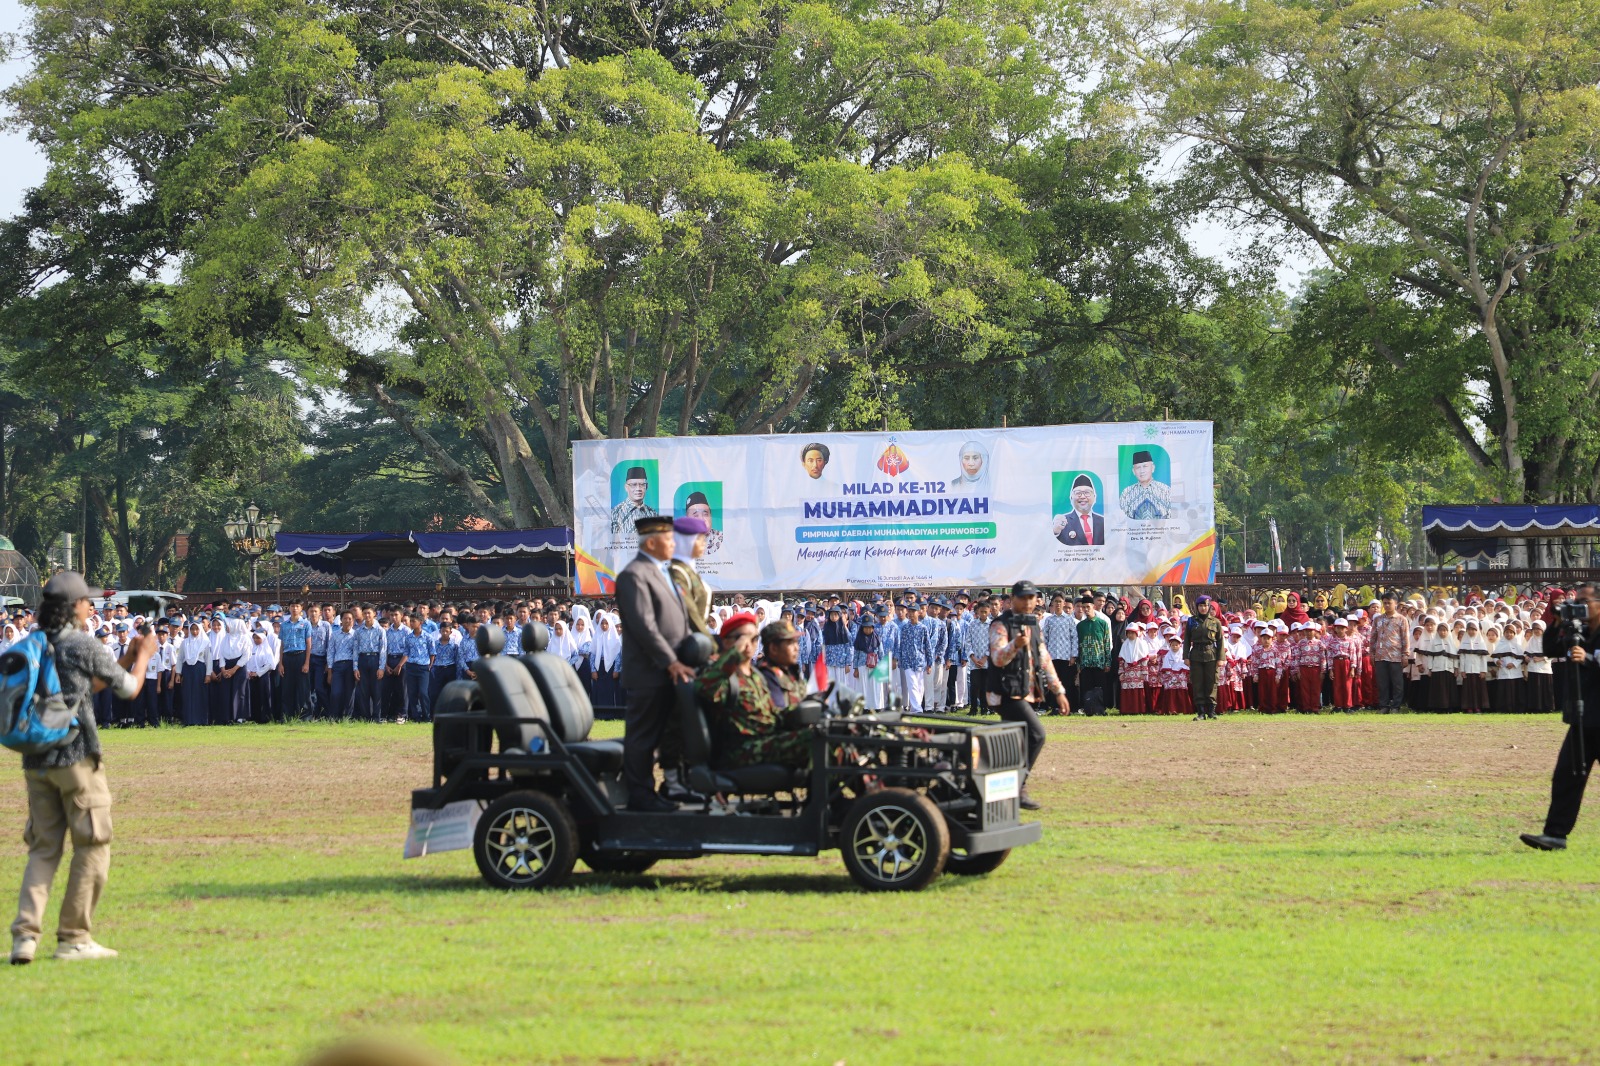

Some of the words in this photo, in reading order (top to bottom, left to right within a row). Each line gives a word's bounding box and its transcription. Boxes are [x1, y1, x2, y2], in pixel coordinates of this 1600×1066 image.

[842, 483, 894, 495] MILAD
[899, 481, 946, 494] KE-112
[804, 497, 989, 519] MUHAMMADIYAH
[802, 530, 840, 538] PIMPINAN
[841, 529, 872, 538] DAERAH
[874, 528, 939, 537] MUHAMMADIYAH
[940, 527, 989, 536] PURWOREJO
[797, 546, 861, 562] Menghadirkan
[864, 545, 927, 561] Kemakmuran
[930, 544, 958, 560] Untuk
[962, 546, 996, 557] Semua
